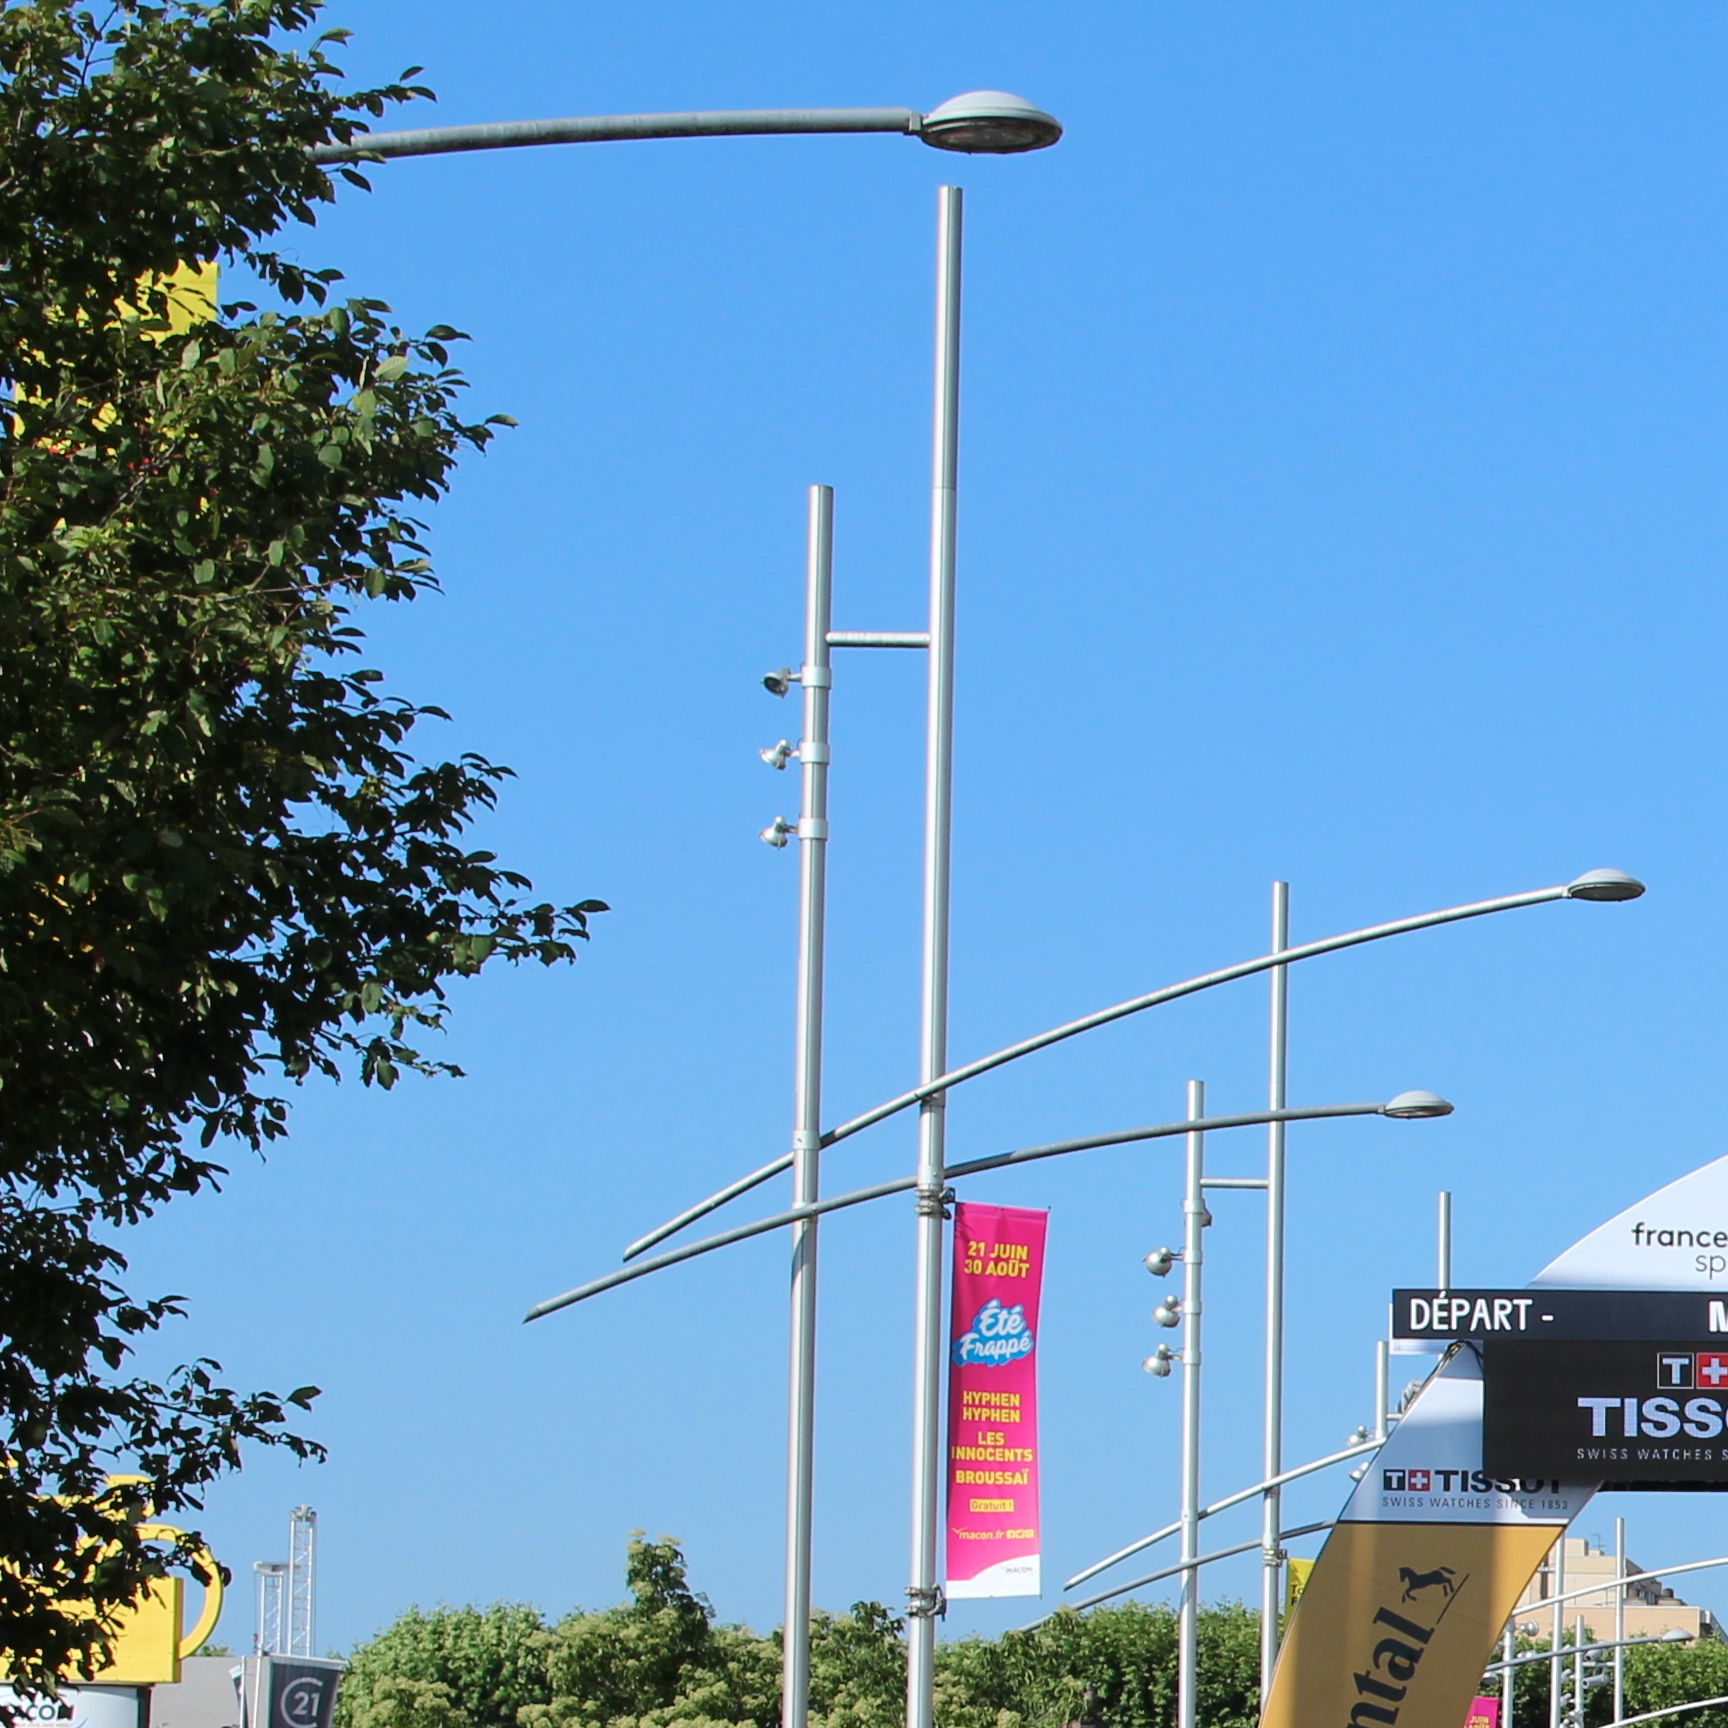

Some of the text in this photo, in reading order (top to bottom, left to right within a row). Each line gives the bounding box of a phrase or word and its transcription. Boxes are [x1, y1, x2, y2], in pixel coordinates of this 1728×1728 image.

[967, 1241, 1028, 1261] 21 JUIN
[964, 1258, 983, 1276] 30
[1409, 1290, 1533, 1333] DÉPART
[958, 1330, 1034, 1362] Frappé
[963, 1390, 1020, 1407] HYPHEN
[962, 1407, 1021, 1424] HYPHEN
[977, 1431, 1005, 1446] LES
[951, 1446, 1034, 1463] INNOCENTS
[1577, 1447, 1629, 1461] SWISS
[1637, 1447, 1713, 1462] WATCHES
[1382, 1496, 1569, 1511] SWISS WATCHES SINCE 1853
[1470, 1715, 1490, 1726] JUIN
